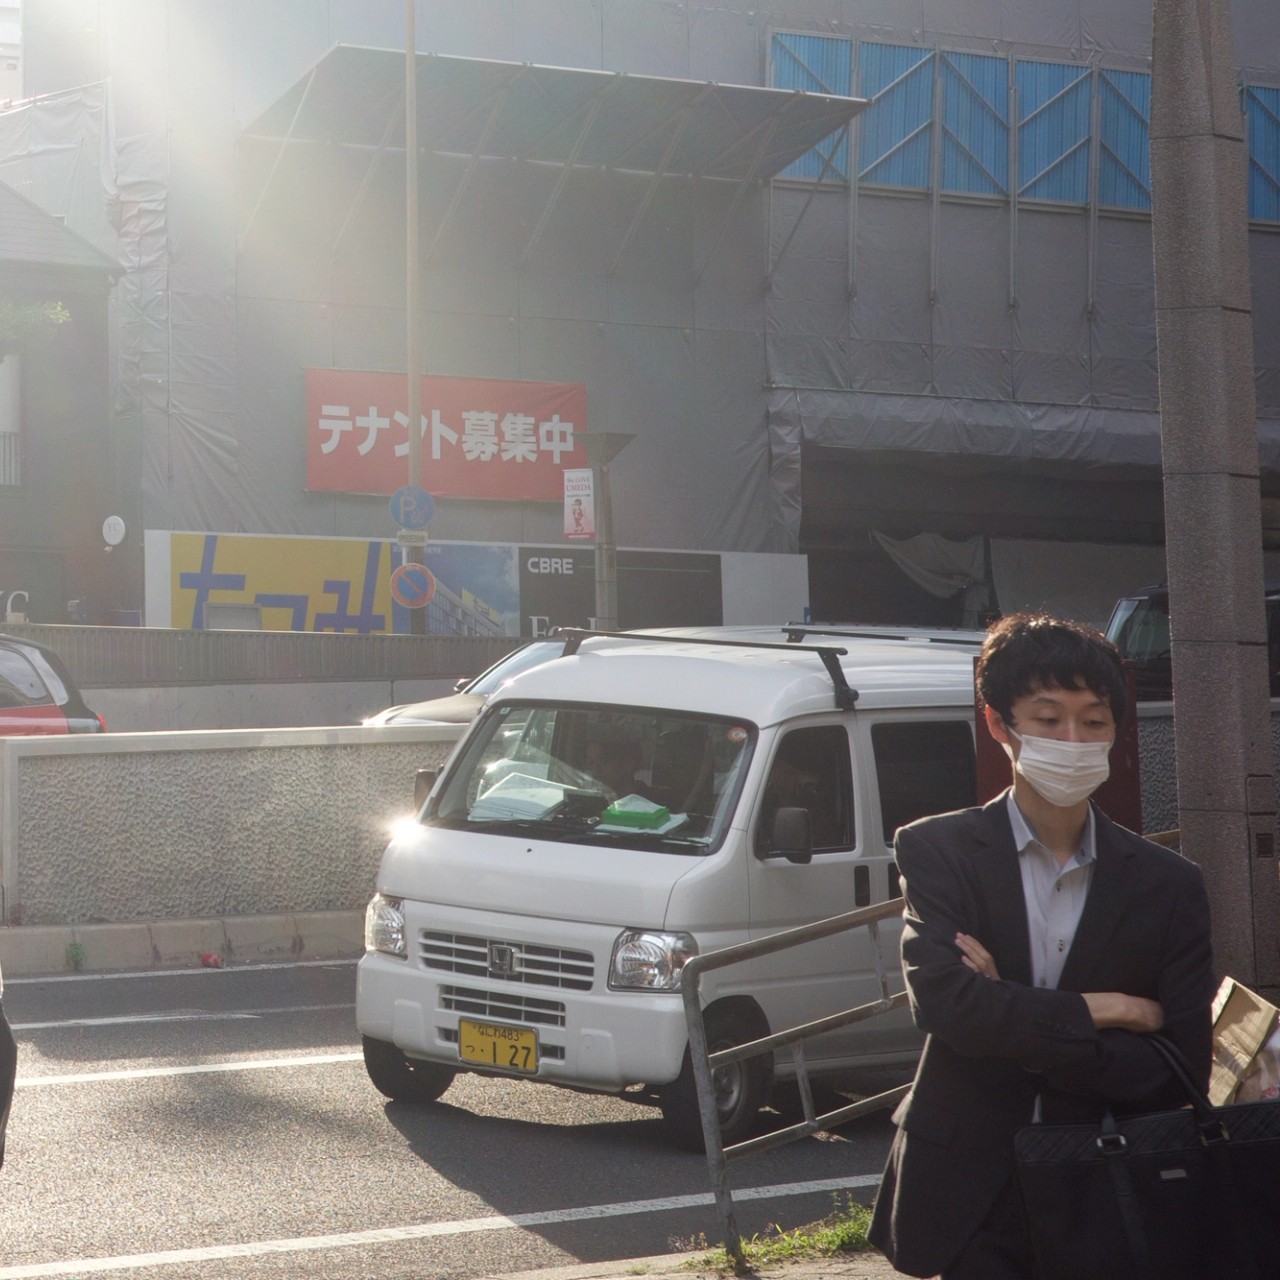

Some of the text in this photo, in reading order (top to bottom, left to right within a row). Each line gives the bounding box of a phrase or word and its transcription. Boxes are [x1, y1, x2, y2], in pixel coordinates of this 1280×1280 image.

[318, 404, 575, 465] テナント募集中
[400, 496, 416, 522] P
[528, 558, 574, 575] CBRE
